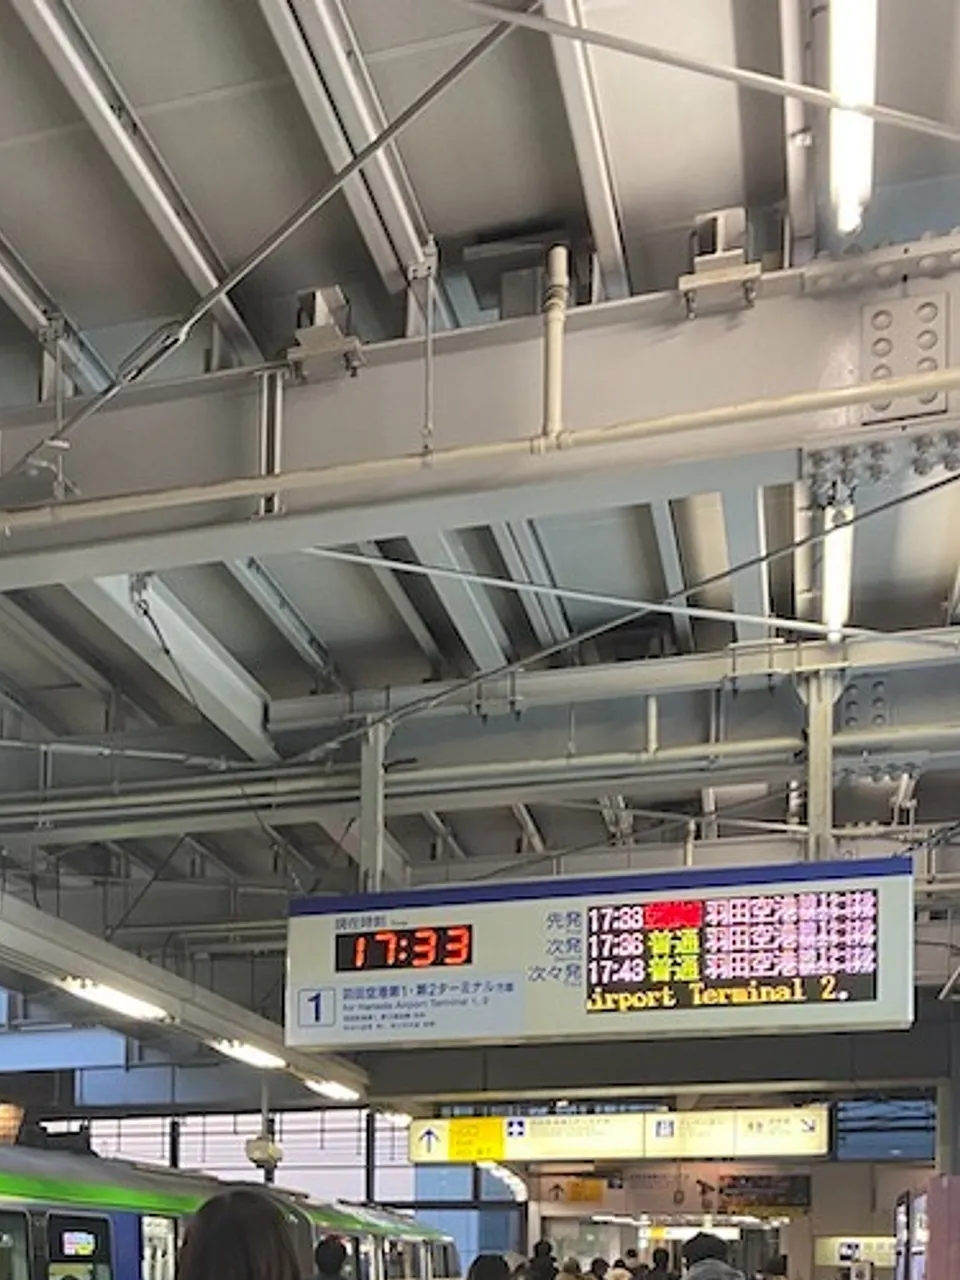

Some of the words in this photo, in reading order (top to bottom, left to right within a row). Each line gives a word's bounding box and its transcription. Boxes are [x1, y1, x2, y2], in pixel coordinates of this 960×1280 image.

[547, 911, 582, 929] 先発
[353, 926, 470, 967] 17:33
[546, 937, 582, 955] 次発
[647, 928, 700, 955] 普通
[589, 959, 645, 984] 17:43
[647, 955, 700, 981] 普通
[689, 978, 807, 1005] Terminal
[308, 992, 321, 1022] 1
